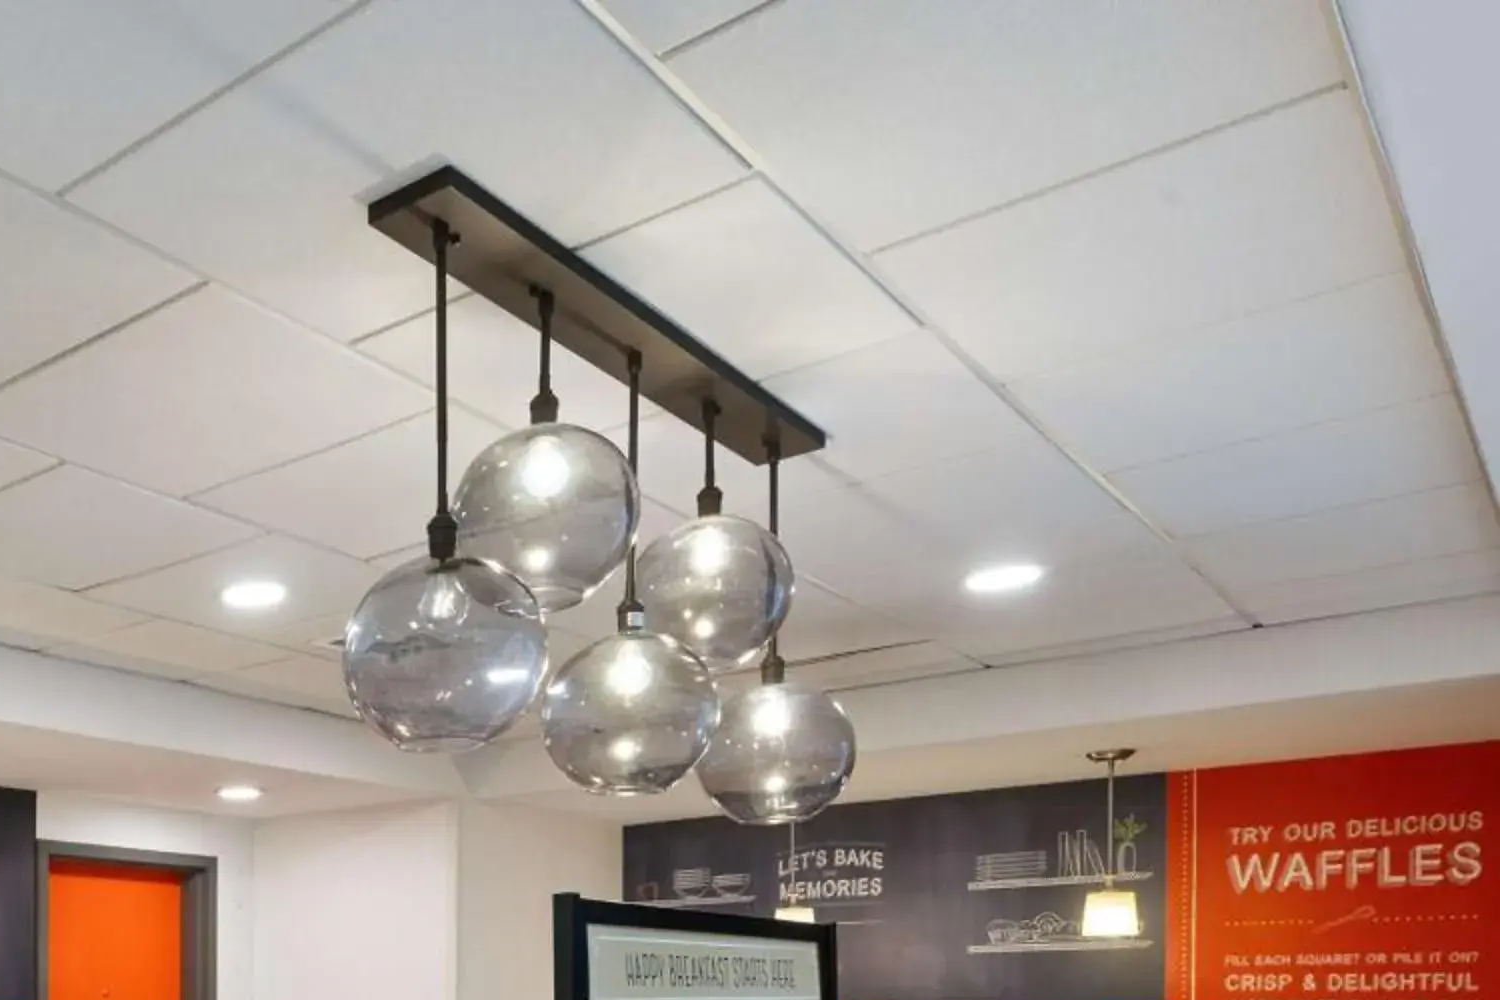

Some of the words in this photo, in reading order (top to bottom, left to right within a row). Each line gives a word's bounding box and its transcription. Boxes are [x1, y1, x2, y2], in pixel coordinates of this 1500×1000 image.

[1228, 826, 1273, 845] TRY
[1283, 821, 1336, 842] OUR
[1346, 811, 1483, 838] DELICIOUS
[778, 849, 827, 877] LET'S
[834, 848, 884, 870] BAKE
[1226, 841, 1482, 895] WAFFLES
[779, 877, 883, 901] MEMORIES
[625, 951, 667, 987] HAPPY
[669, 954, 730, 987] BREAKFAST
[733, 957, 768, 988] STARTS
[771, 958, 797, 989] HERE
[1255, 954, 1291, 965] EACH
[1296, 952, 1360, 965] SQUARE?
[1365, 952, 1387, 964] OR
[1429, 951, 1442, 963] IT
[1449, 951, 1479, 963] ON?
[1224, 973, 1293, 992] CRISP
[1302, 973, 1317, 991] &
[1327, 971, 1479, 991] DELIGHTFUL
